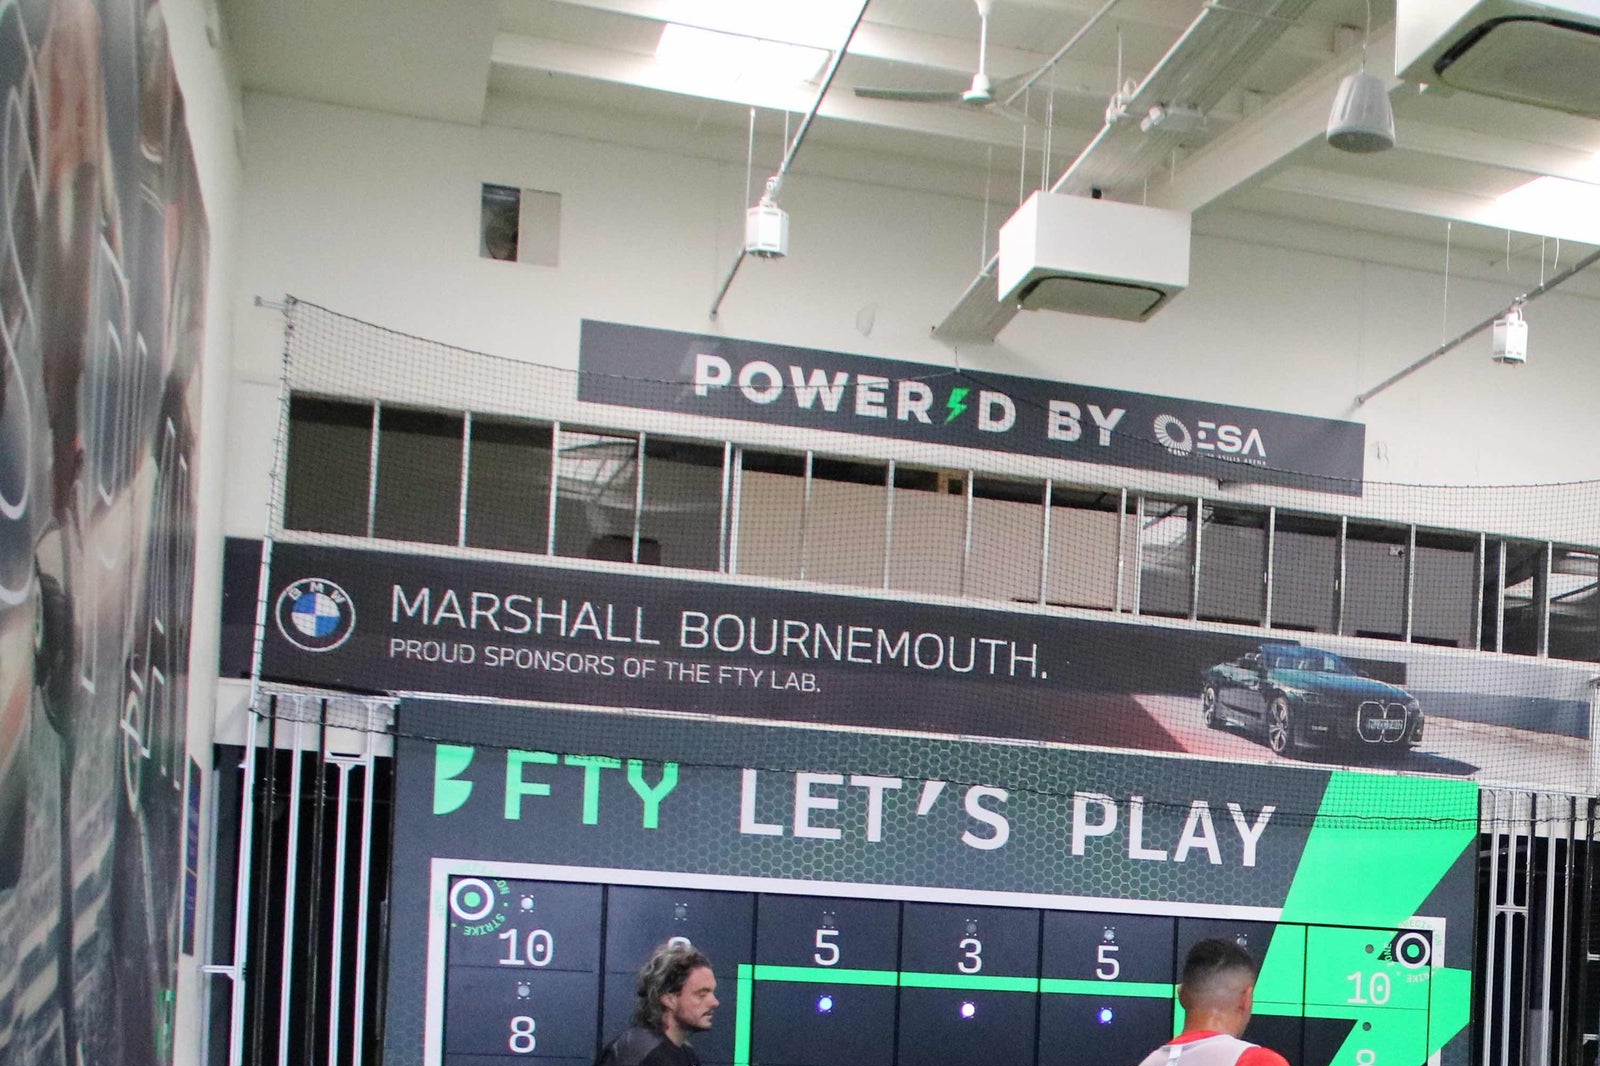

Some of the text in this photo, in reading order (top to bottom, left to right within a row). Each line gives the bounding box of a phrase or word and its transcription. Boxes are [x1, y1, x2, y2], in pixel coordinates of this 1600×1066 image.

[1048, 400, 1126, 447] BY
[391, 584, 1048, 679] MARSHALL BOURNEMOUTH.
[389, 638, 821, 693] PROUD SPONSORS OF THE FTY LAB.
[740, 768, 1010, 851] LET'S
[1071, 790, 1276, 867] PLAY
[499, 928, 554, 967] 10
[814, 930, 840, 966] 5
[957, 938, 983, 974] 3
[1096, 945, 1120, 980] 5
[1347, 971, 1391, 1005] 10
[509, 1016, 536, 1053] 8
